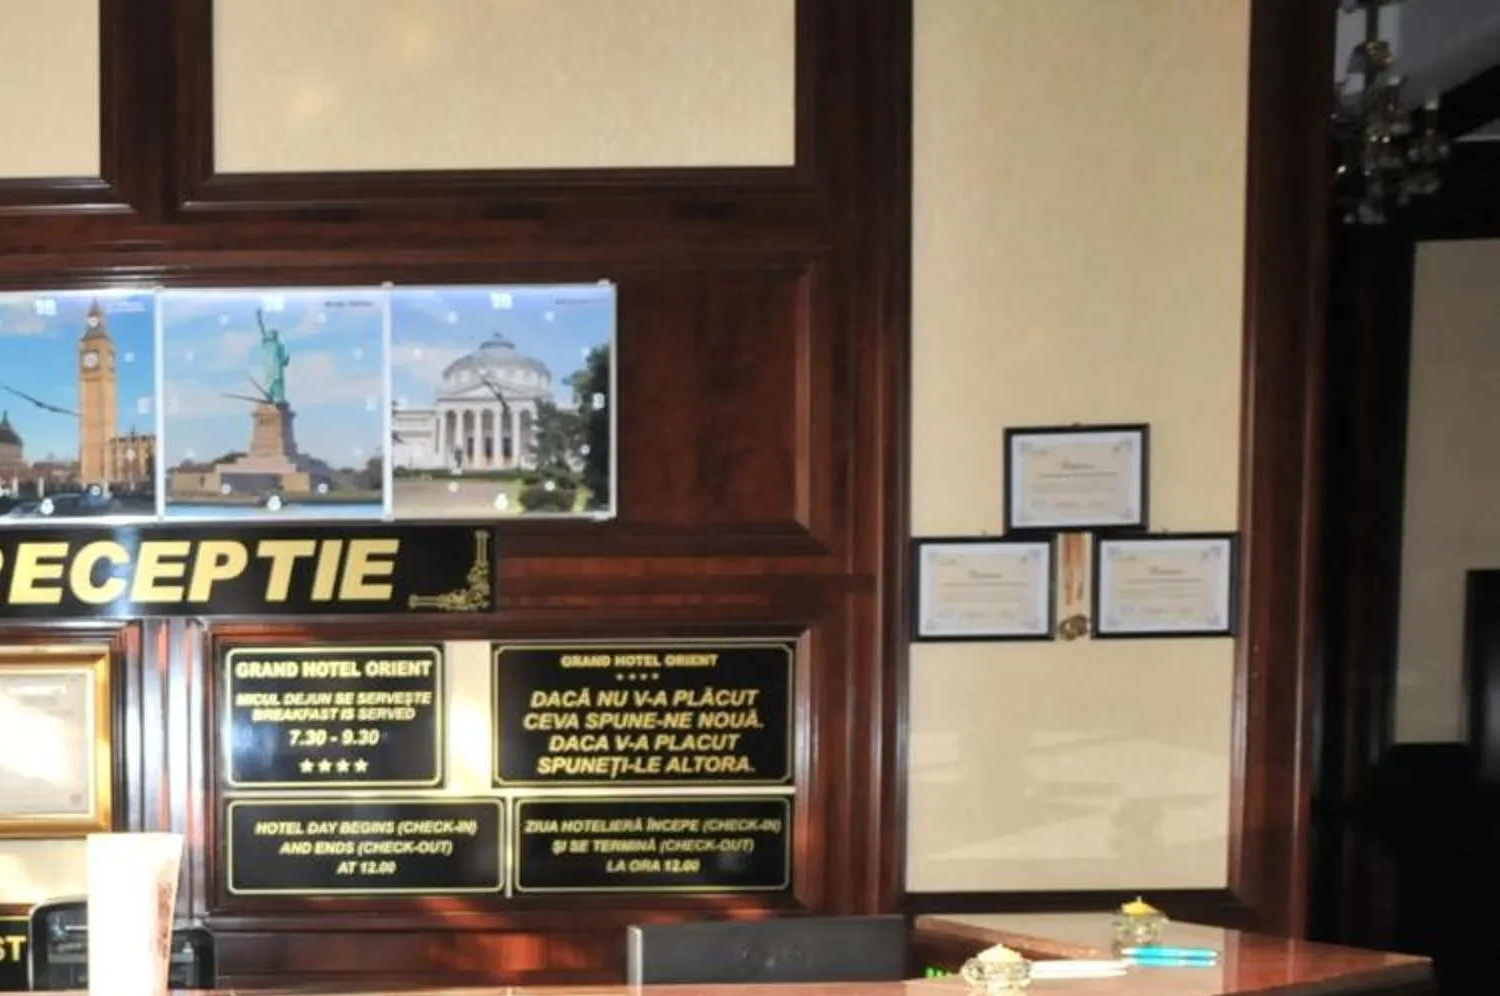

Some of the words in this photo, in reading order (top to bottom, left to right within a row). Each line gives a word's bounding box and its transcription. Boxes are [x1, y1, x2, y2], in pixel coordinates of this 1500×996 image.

[560, 654, 611, 668] GRAND
[614, 654, 662, 667] HOTEL
[664, 653, 719, 667] ORIENT
[235, 660, 299, 678] GRAND
[301, 660, 362, 677] HOTEL
[364, 659, 432, 677] ORIENT
[596, 690, 628, 707] NU
[633, 690, 668, 706] V-A
[357, 707, 416, 720] SERVED
[523, 711, 580, 730] CEVA
[584, 711, 693, 730] SPUNE-NE
[289, 730, 327, 746] 7.30
[614, 733, 649, 750] V-A
[666, 755, 756, 774] ALTORA.
[255, 822, 304, 835] HOTEL
[306, 821, 339, 834] DAY
[340, 821, 394, 834] BEGINS
[279, 841, 313, 855] AND
[314, 841, 355, 854] ENDS
[336, 862, 357, 874] AT
[606, 860, 627, 872] LA
